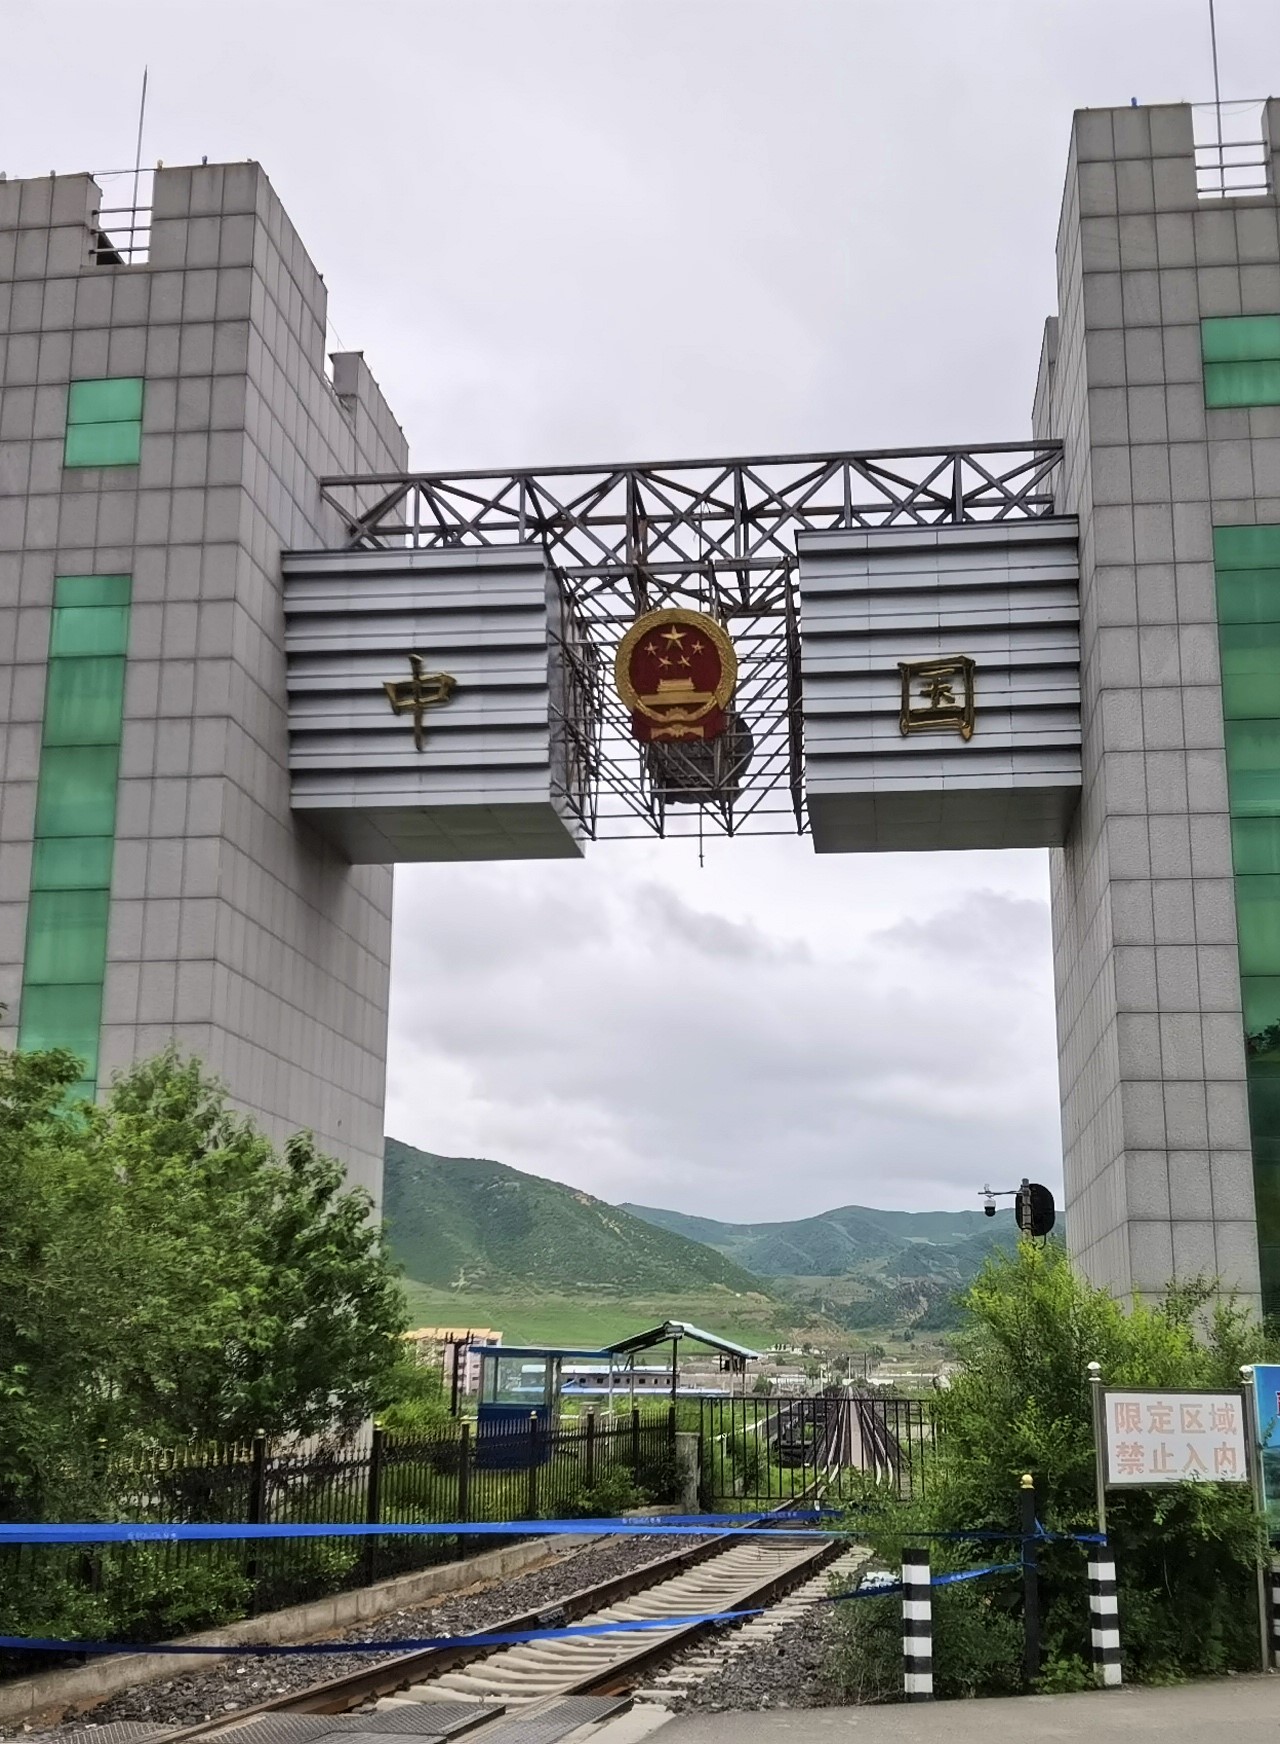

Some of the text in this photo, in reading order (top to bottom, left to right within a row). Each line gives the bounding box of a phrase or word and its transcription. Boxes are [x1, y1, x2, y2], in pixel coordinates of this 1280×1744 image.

[382, 653, 976, 752] 中 国
[1114, 1401, 1238, 1435] 限定区域
[1115, 1441, 1238, 1475] 禁止入内
